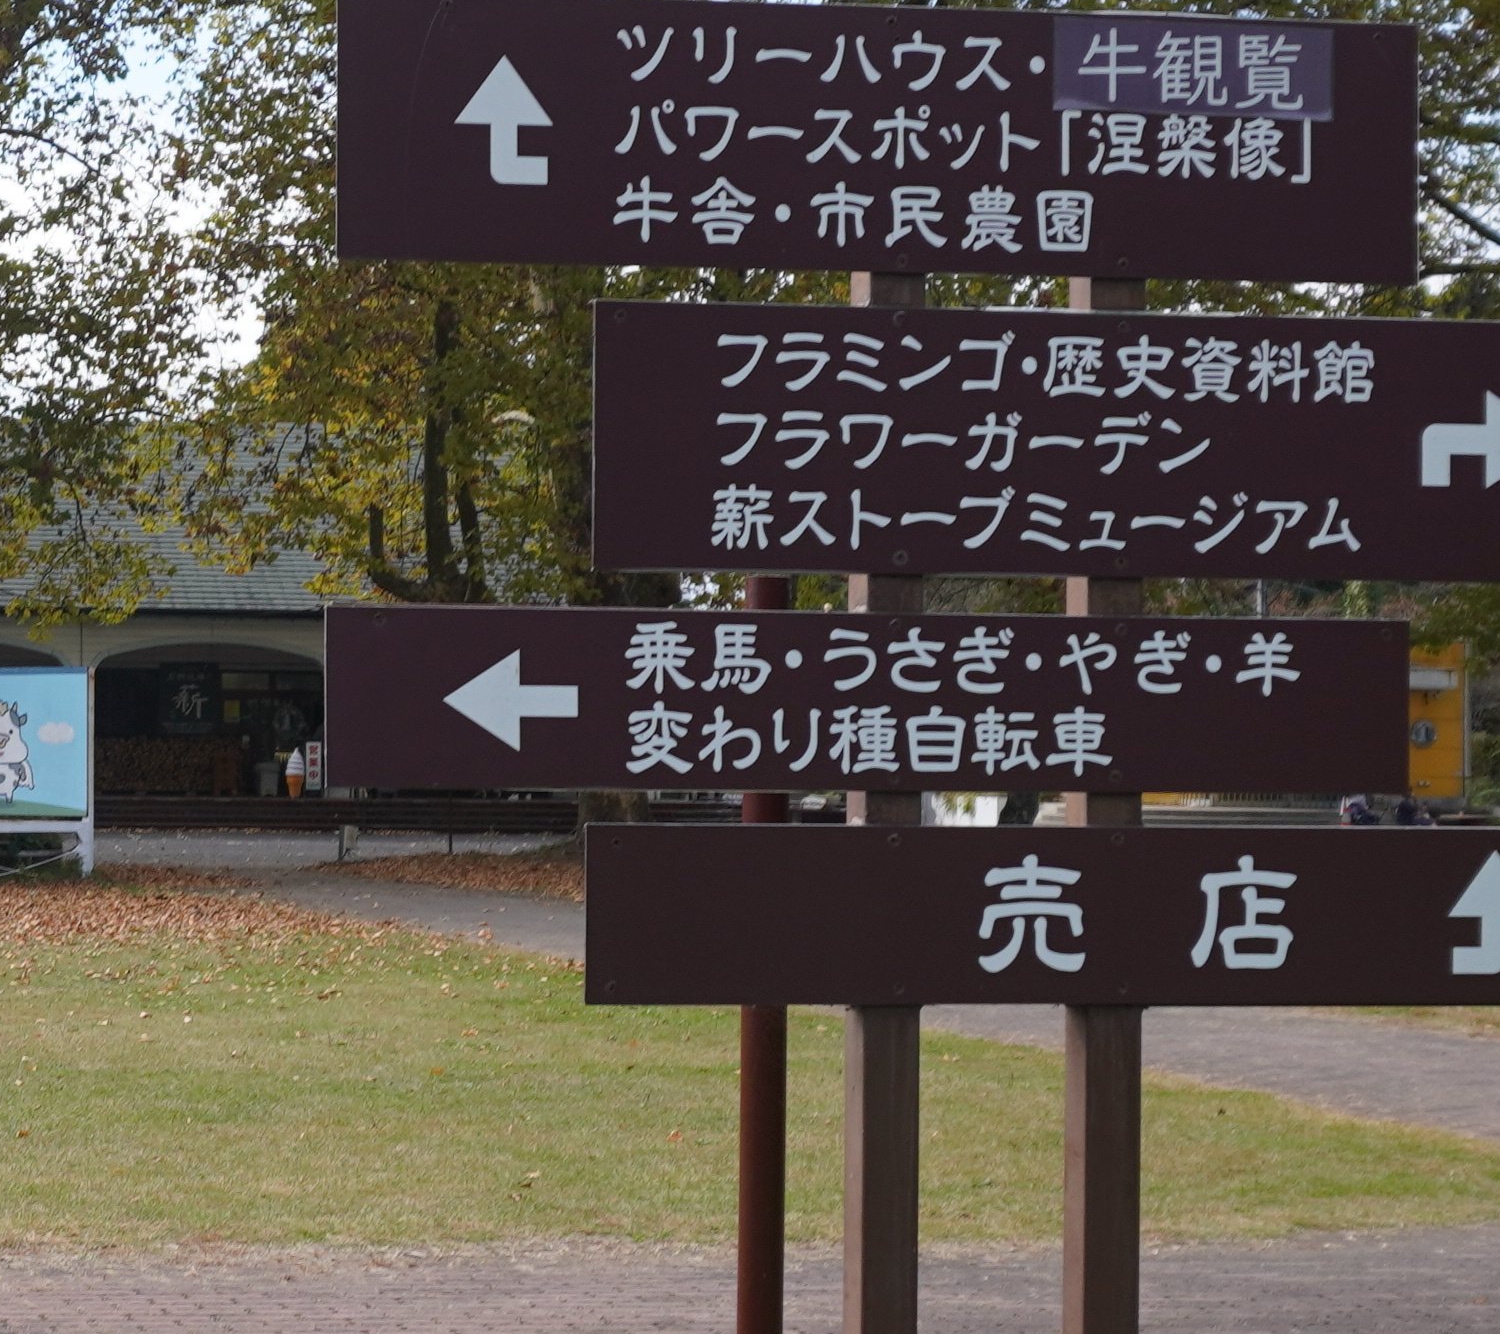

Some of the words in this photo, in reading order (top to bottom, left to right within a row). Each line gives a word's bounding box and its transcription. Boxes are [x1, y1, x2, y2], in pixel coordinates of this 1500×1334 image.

[616, 25, 1304, 111] ツリーハウス・牛観覧
[613, 98, 1312, 185] パワースポット「涅槃像」
[612, 174, 1095, 254] 牛舎・市民農園
[716, 328, 1376, 404] フラミンゴ・歴史資料館
[715, 409, 1212, 475] フラワーガーデン
[710, 482, 1363, 555] 薪ストーブミュージアム
[623, 620, 1301, 698] 乗馬・うさぎ・やぎ・羊
[625, 700, 1114, 778] 変わり種自転車
[977, 853, 1299, 974] 売店
